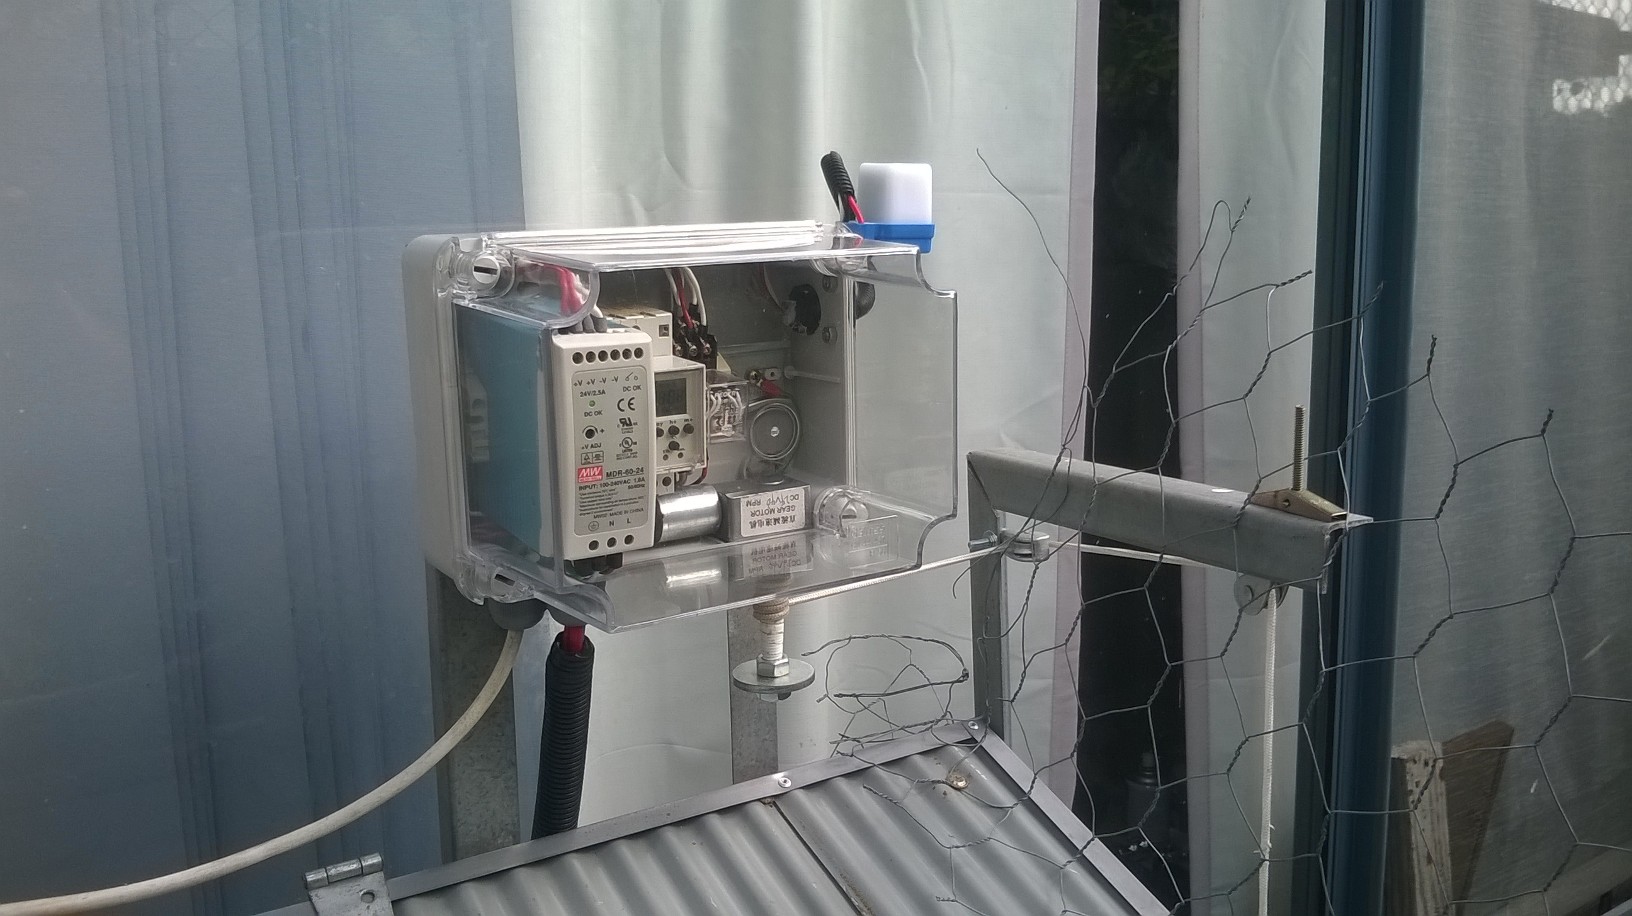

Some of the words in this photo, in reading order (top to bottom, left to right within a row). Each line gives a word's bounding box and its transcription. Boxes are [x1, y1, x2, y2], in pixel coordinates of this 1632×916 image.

[586, 378, 596, 386] +V
[580, 389, 606, 397] 24V/2.5A
[617, 397, 636, 412] CE
[579, 466, 602, 477] MW
[606, 467, 645, 478] MDR-60-24
[578, 484, 599, 492] INPUT:
[746, 499, 761, 507] RPM
[750, 508, 776, 518] MOTOR
[777, 504, 796, 514] GEAR
